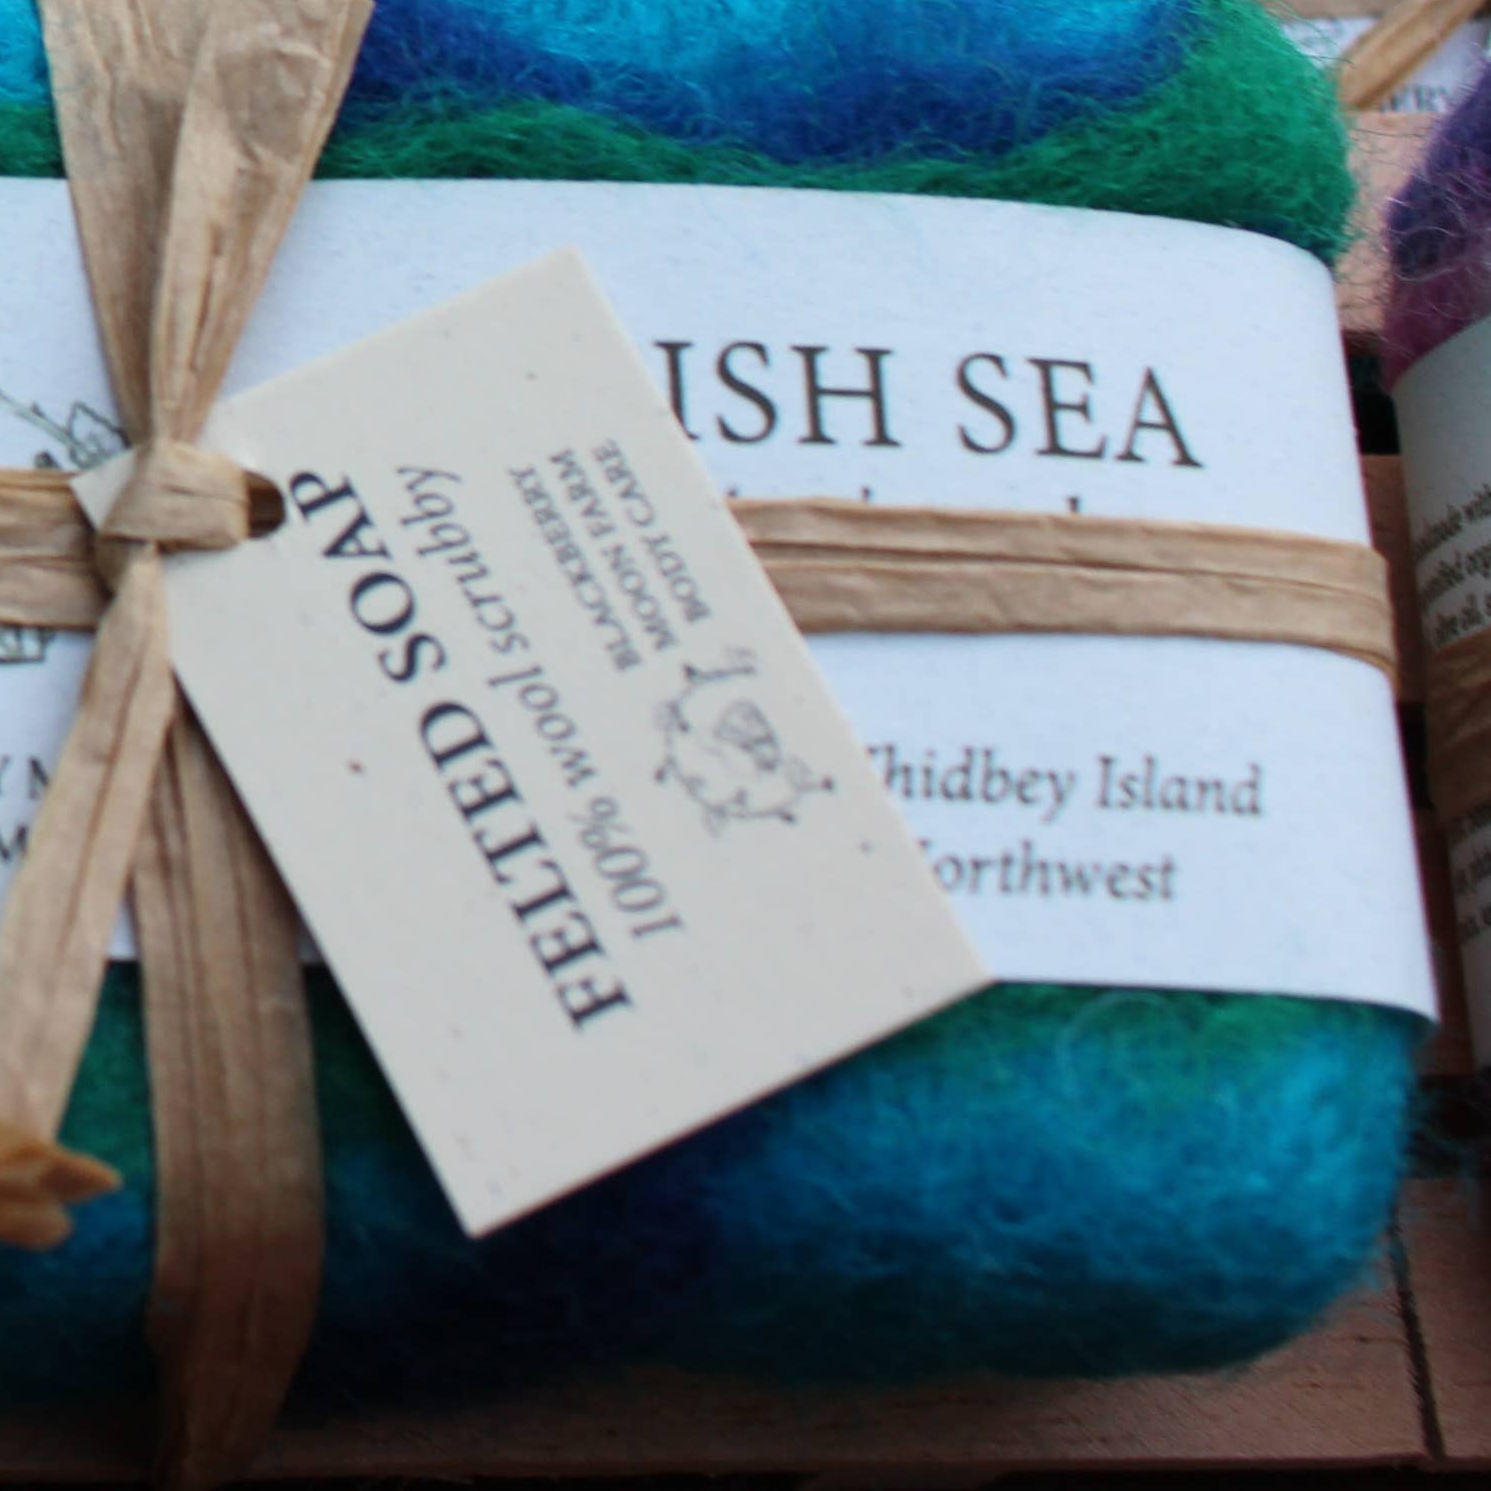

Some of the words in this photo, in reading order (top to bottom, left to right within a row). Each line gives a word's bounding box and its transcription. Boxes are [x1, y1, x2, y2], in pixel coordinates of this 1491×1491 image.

[653, 339, 903, 449] ISH
[955, 352, 1206, 470] SEA
[548, 447, 618, 539] FARM
[591, 438, 656, 528] CARE
[286, 468, 449, 685] SOAP
[395, 464, 530, 656] scrubby
[507, 466, 644, 672] BLACKBERRY
[599, 543, 677, 652] MOON
[639, 531, 712, 624] BODY
[486, 664, 597, 789] wool
[1096, 753, 1265, 817] Island
[417, 699, 635, 1032] FELTED
[569, 796, 684, 940] 100%
[919, 836, 1179, 901] orthwest
